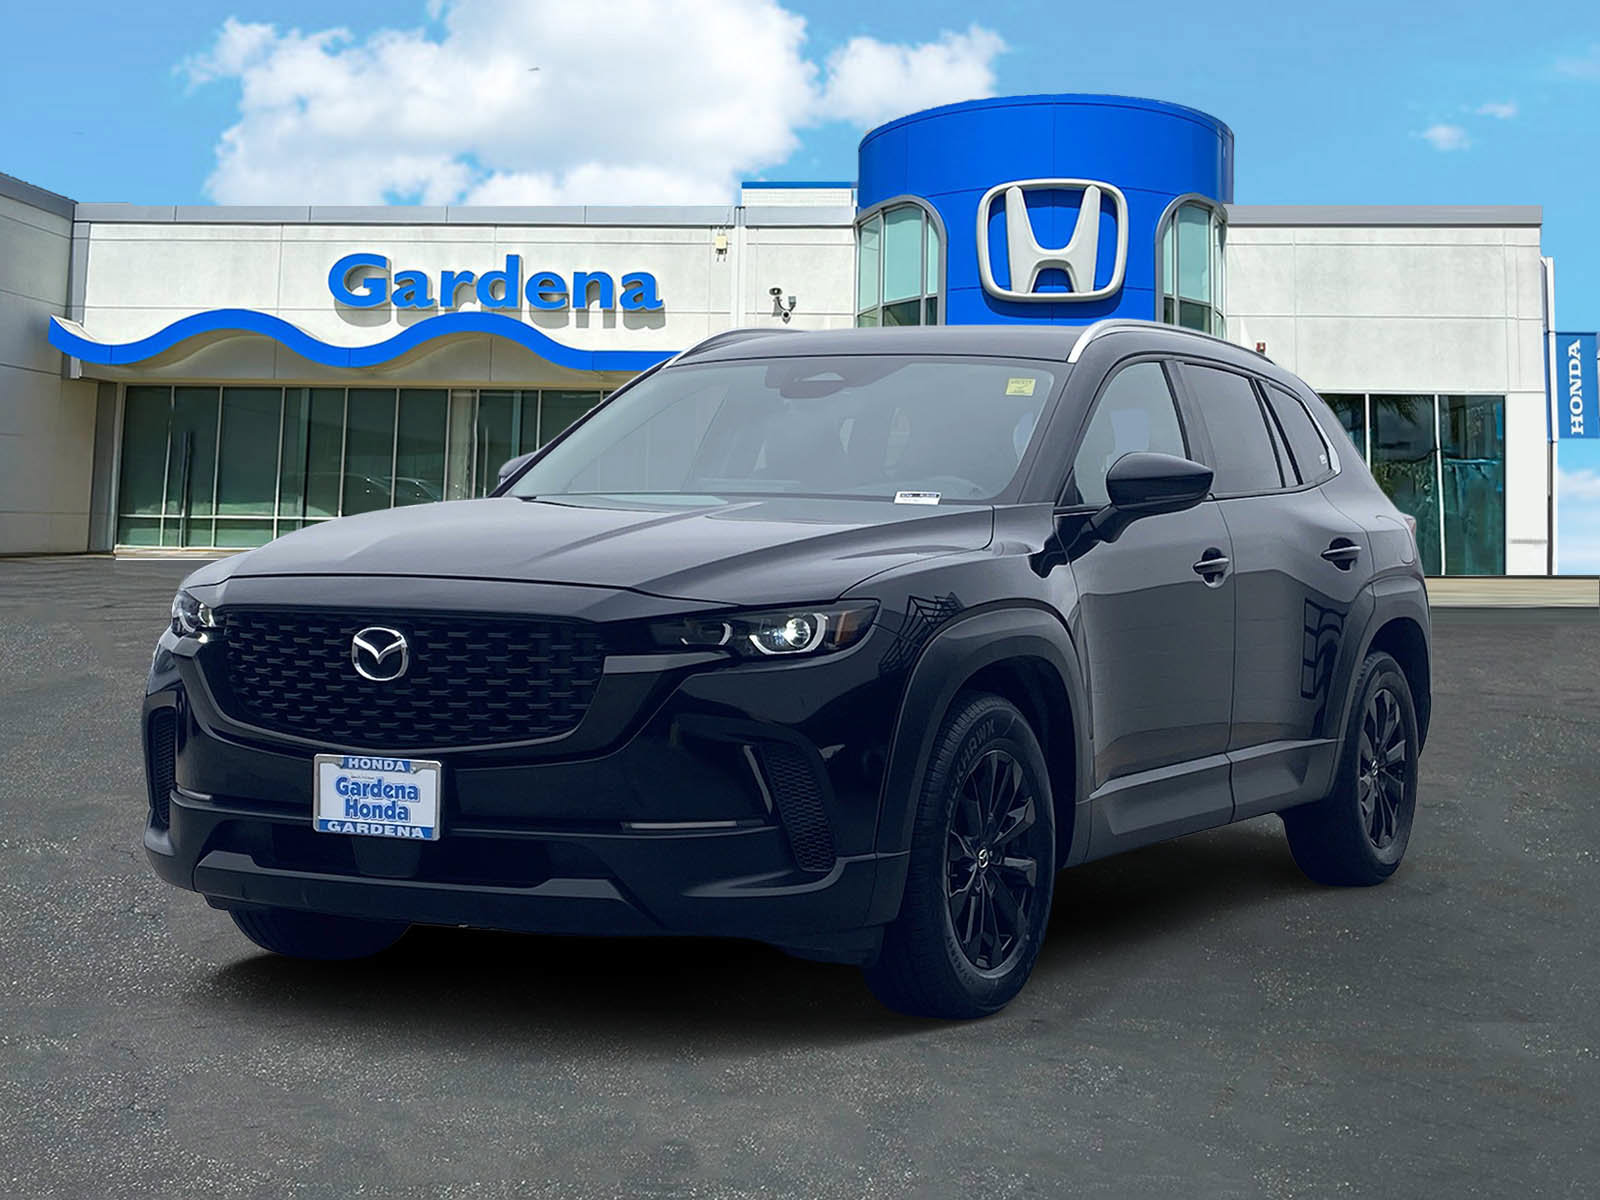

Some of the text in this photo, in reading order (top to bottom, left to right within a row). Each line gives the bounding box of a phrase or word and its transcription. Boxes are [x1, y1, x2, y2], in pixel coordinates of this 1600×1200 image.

[328, 252, 664, 310] Gardena
[1567, 338, 1584, 435] HONDA
[347, 757, 406, 772] HONDA
[335, 776, 419, 800] Gardena
[344, 798, 409, 821] Honda
[327, 821, 425, 838] GARDENA
